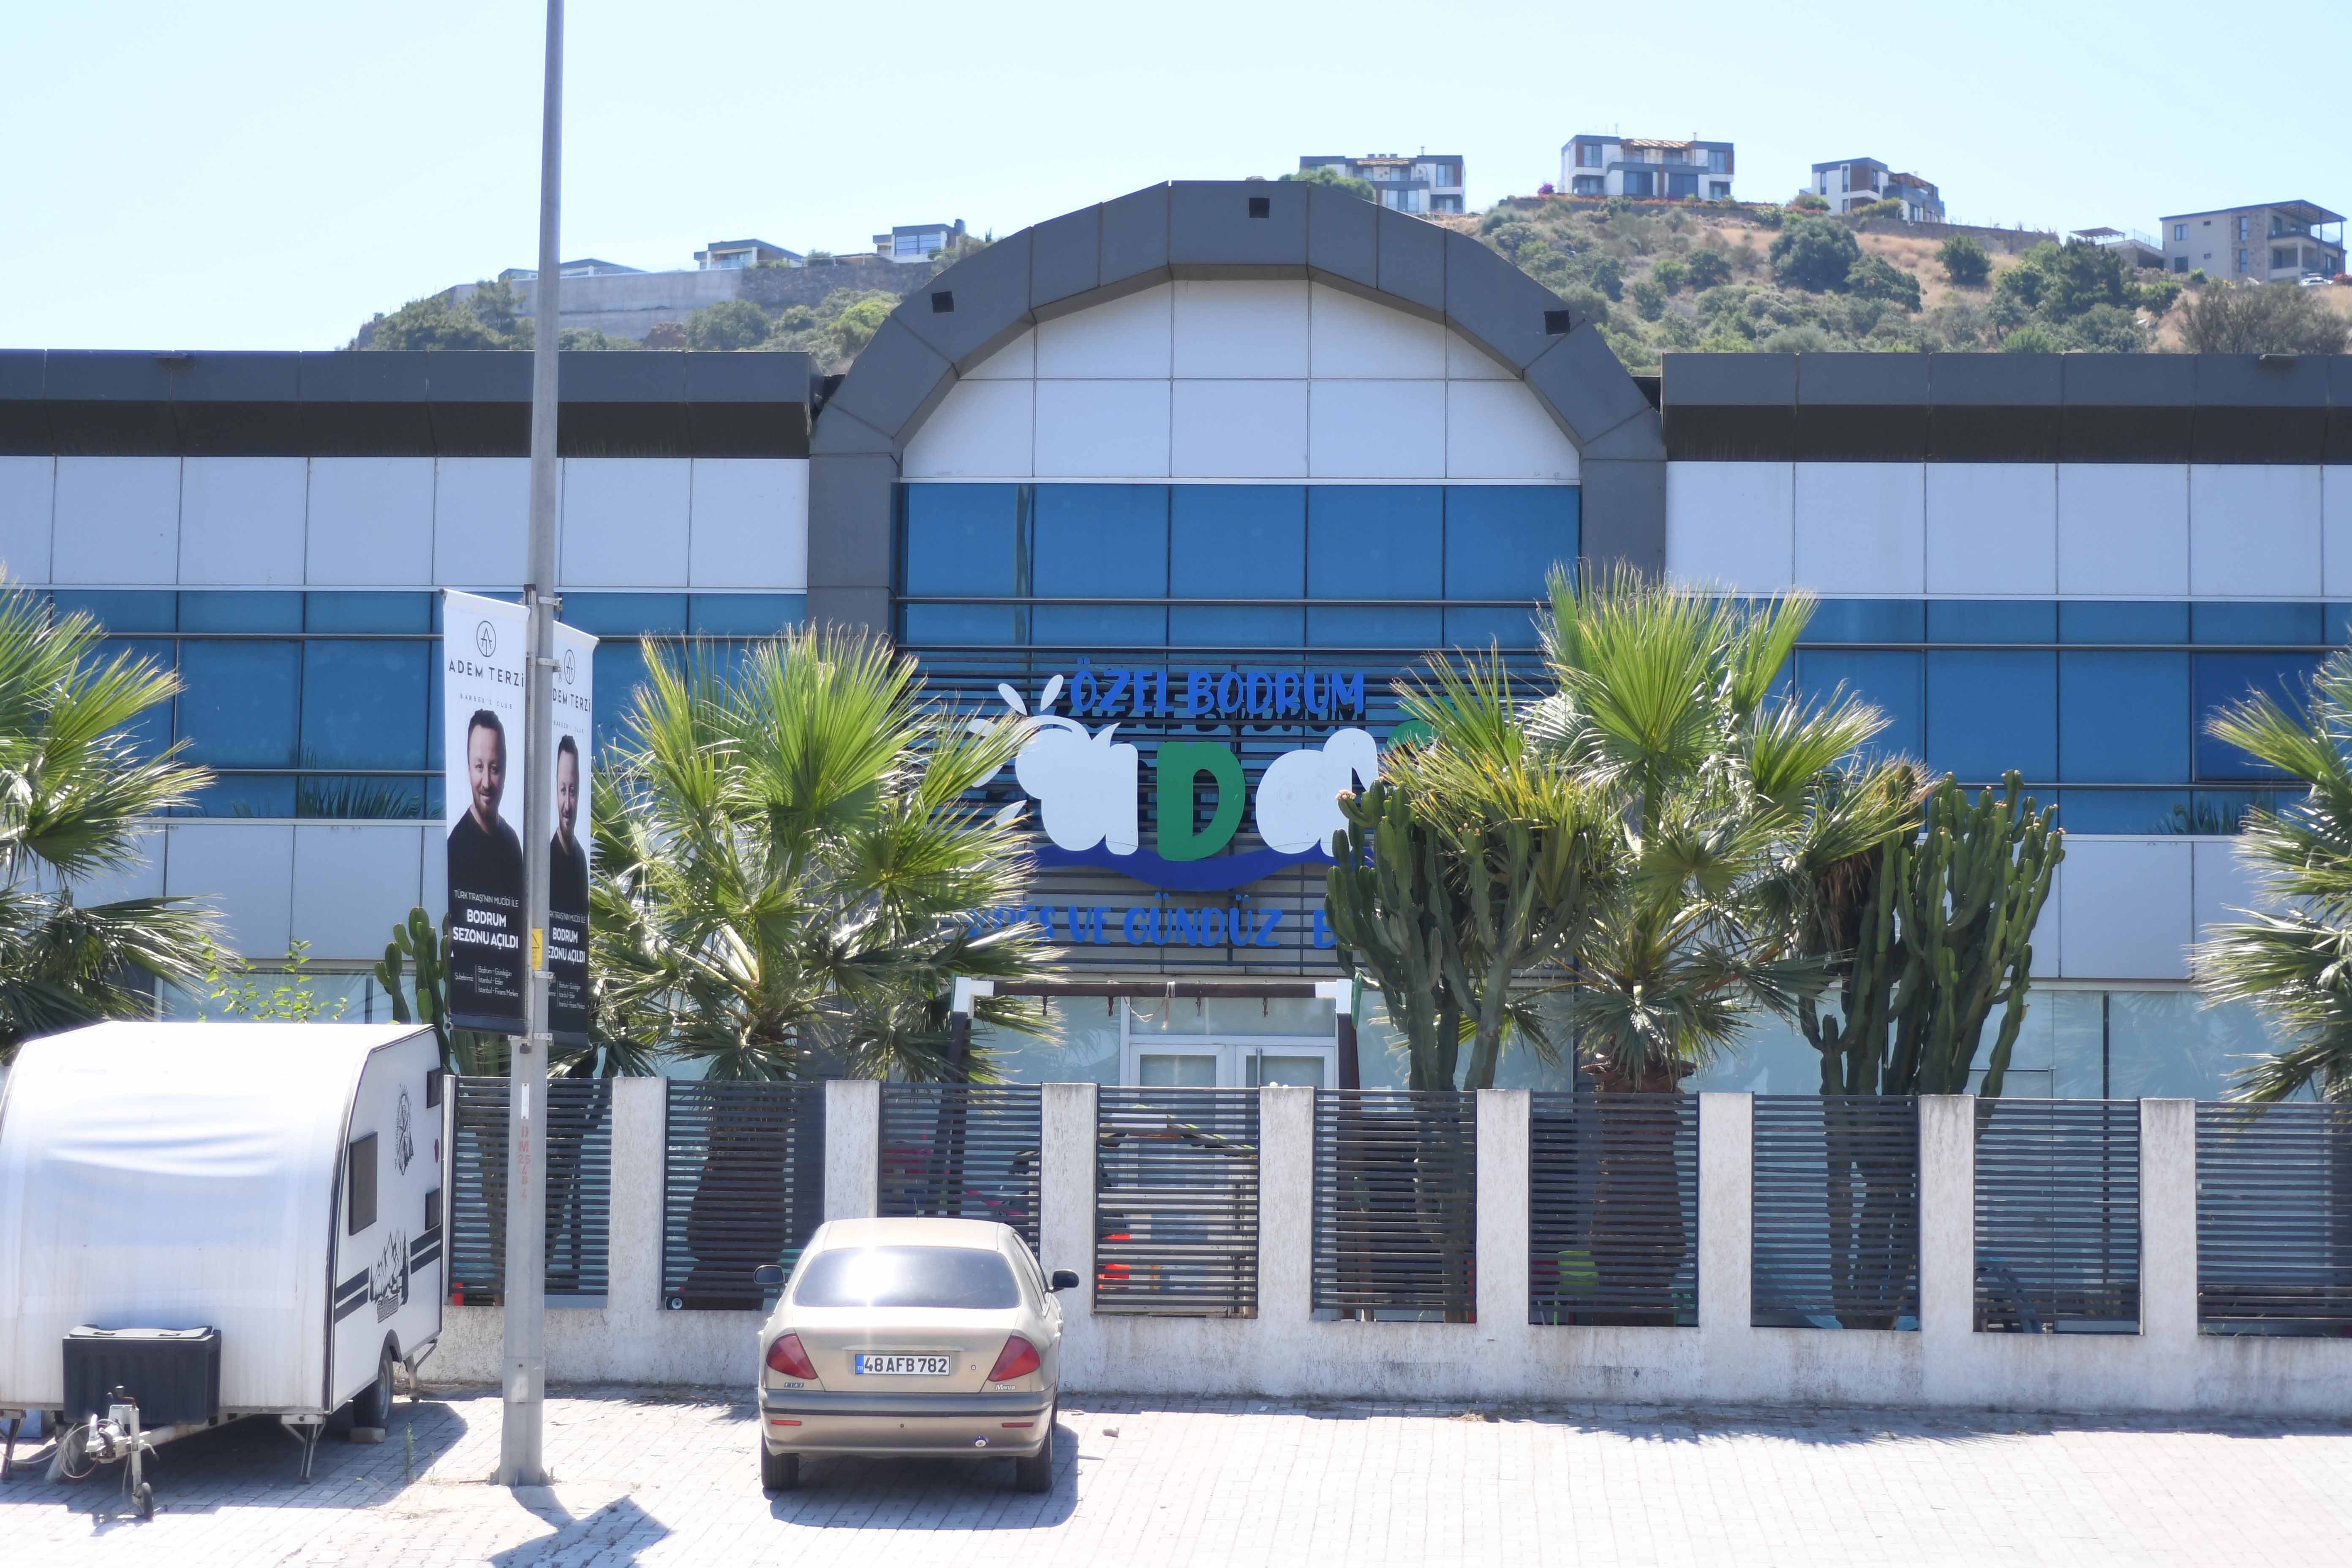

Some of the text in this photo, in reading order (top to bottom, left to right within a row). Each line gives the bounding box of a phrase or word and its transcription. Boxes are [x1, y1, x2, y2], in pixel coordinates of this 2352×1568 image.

[449, 659, 483, 679] ADEM
[1070, 657, 1364, 714] ÖZEL BODRUM
[553, 688, 567, 705] DEM
[454, 889, 468, 899] TÜRK
[467, 909, 506, 927] BODRUM
[1068, 906, 1111, 944] VE
[1123, 892, 1283, 946] GÜNDÜZ
[453, 926, 518, 950] SEZONU AÇILDI
[553, 927, 578, 943] BODRUM
[548, 945, 567, 961] EZONU
[567, 948, 585, 965] AÇILDI
[864, 1357, 947, 1372] 48 AFB 782
